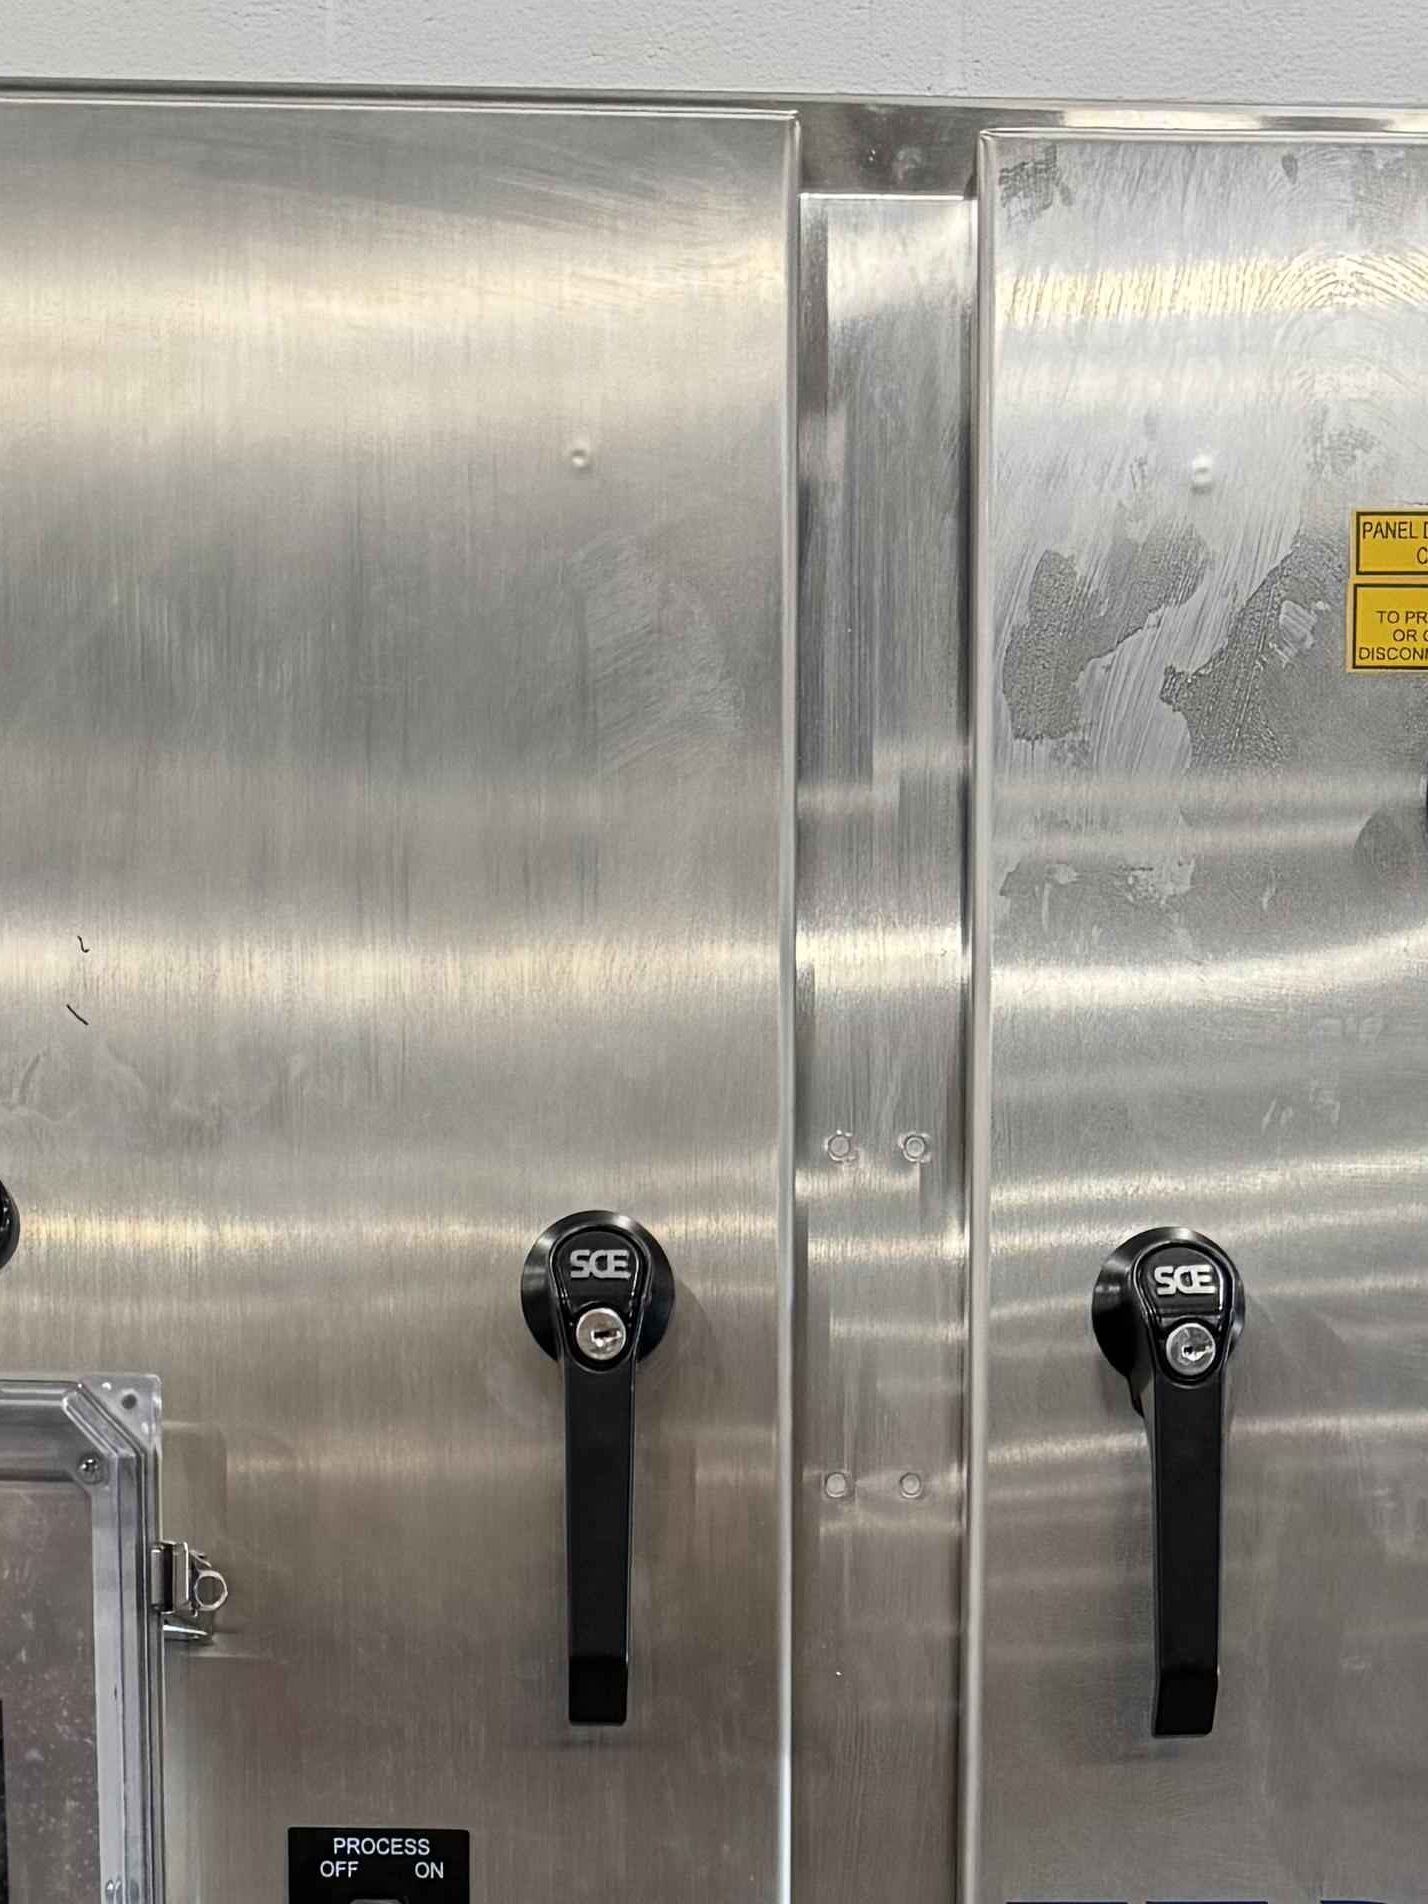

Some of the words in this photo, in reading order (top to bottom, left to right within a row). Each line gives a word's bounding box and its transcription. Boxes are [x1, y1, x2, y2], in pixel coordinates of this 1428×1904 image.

[1362, 522, 1418, 540] PANEL
[1377, 611, 1401, 625] TO
[1392, 628, 1418, 643] OR
[333, 1837, 431, 1856] PROCESS
[320, 1860, 359, 1878] OFF
[414, 1861, 445, 1879] ON
